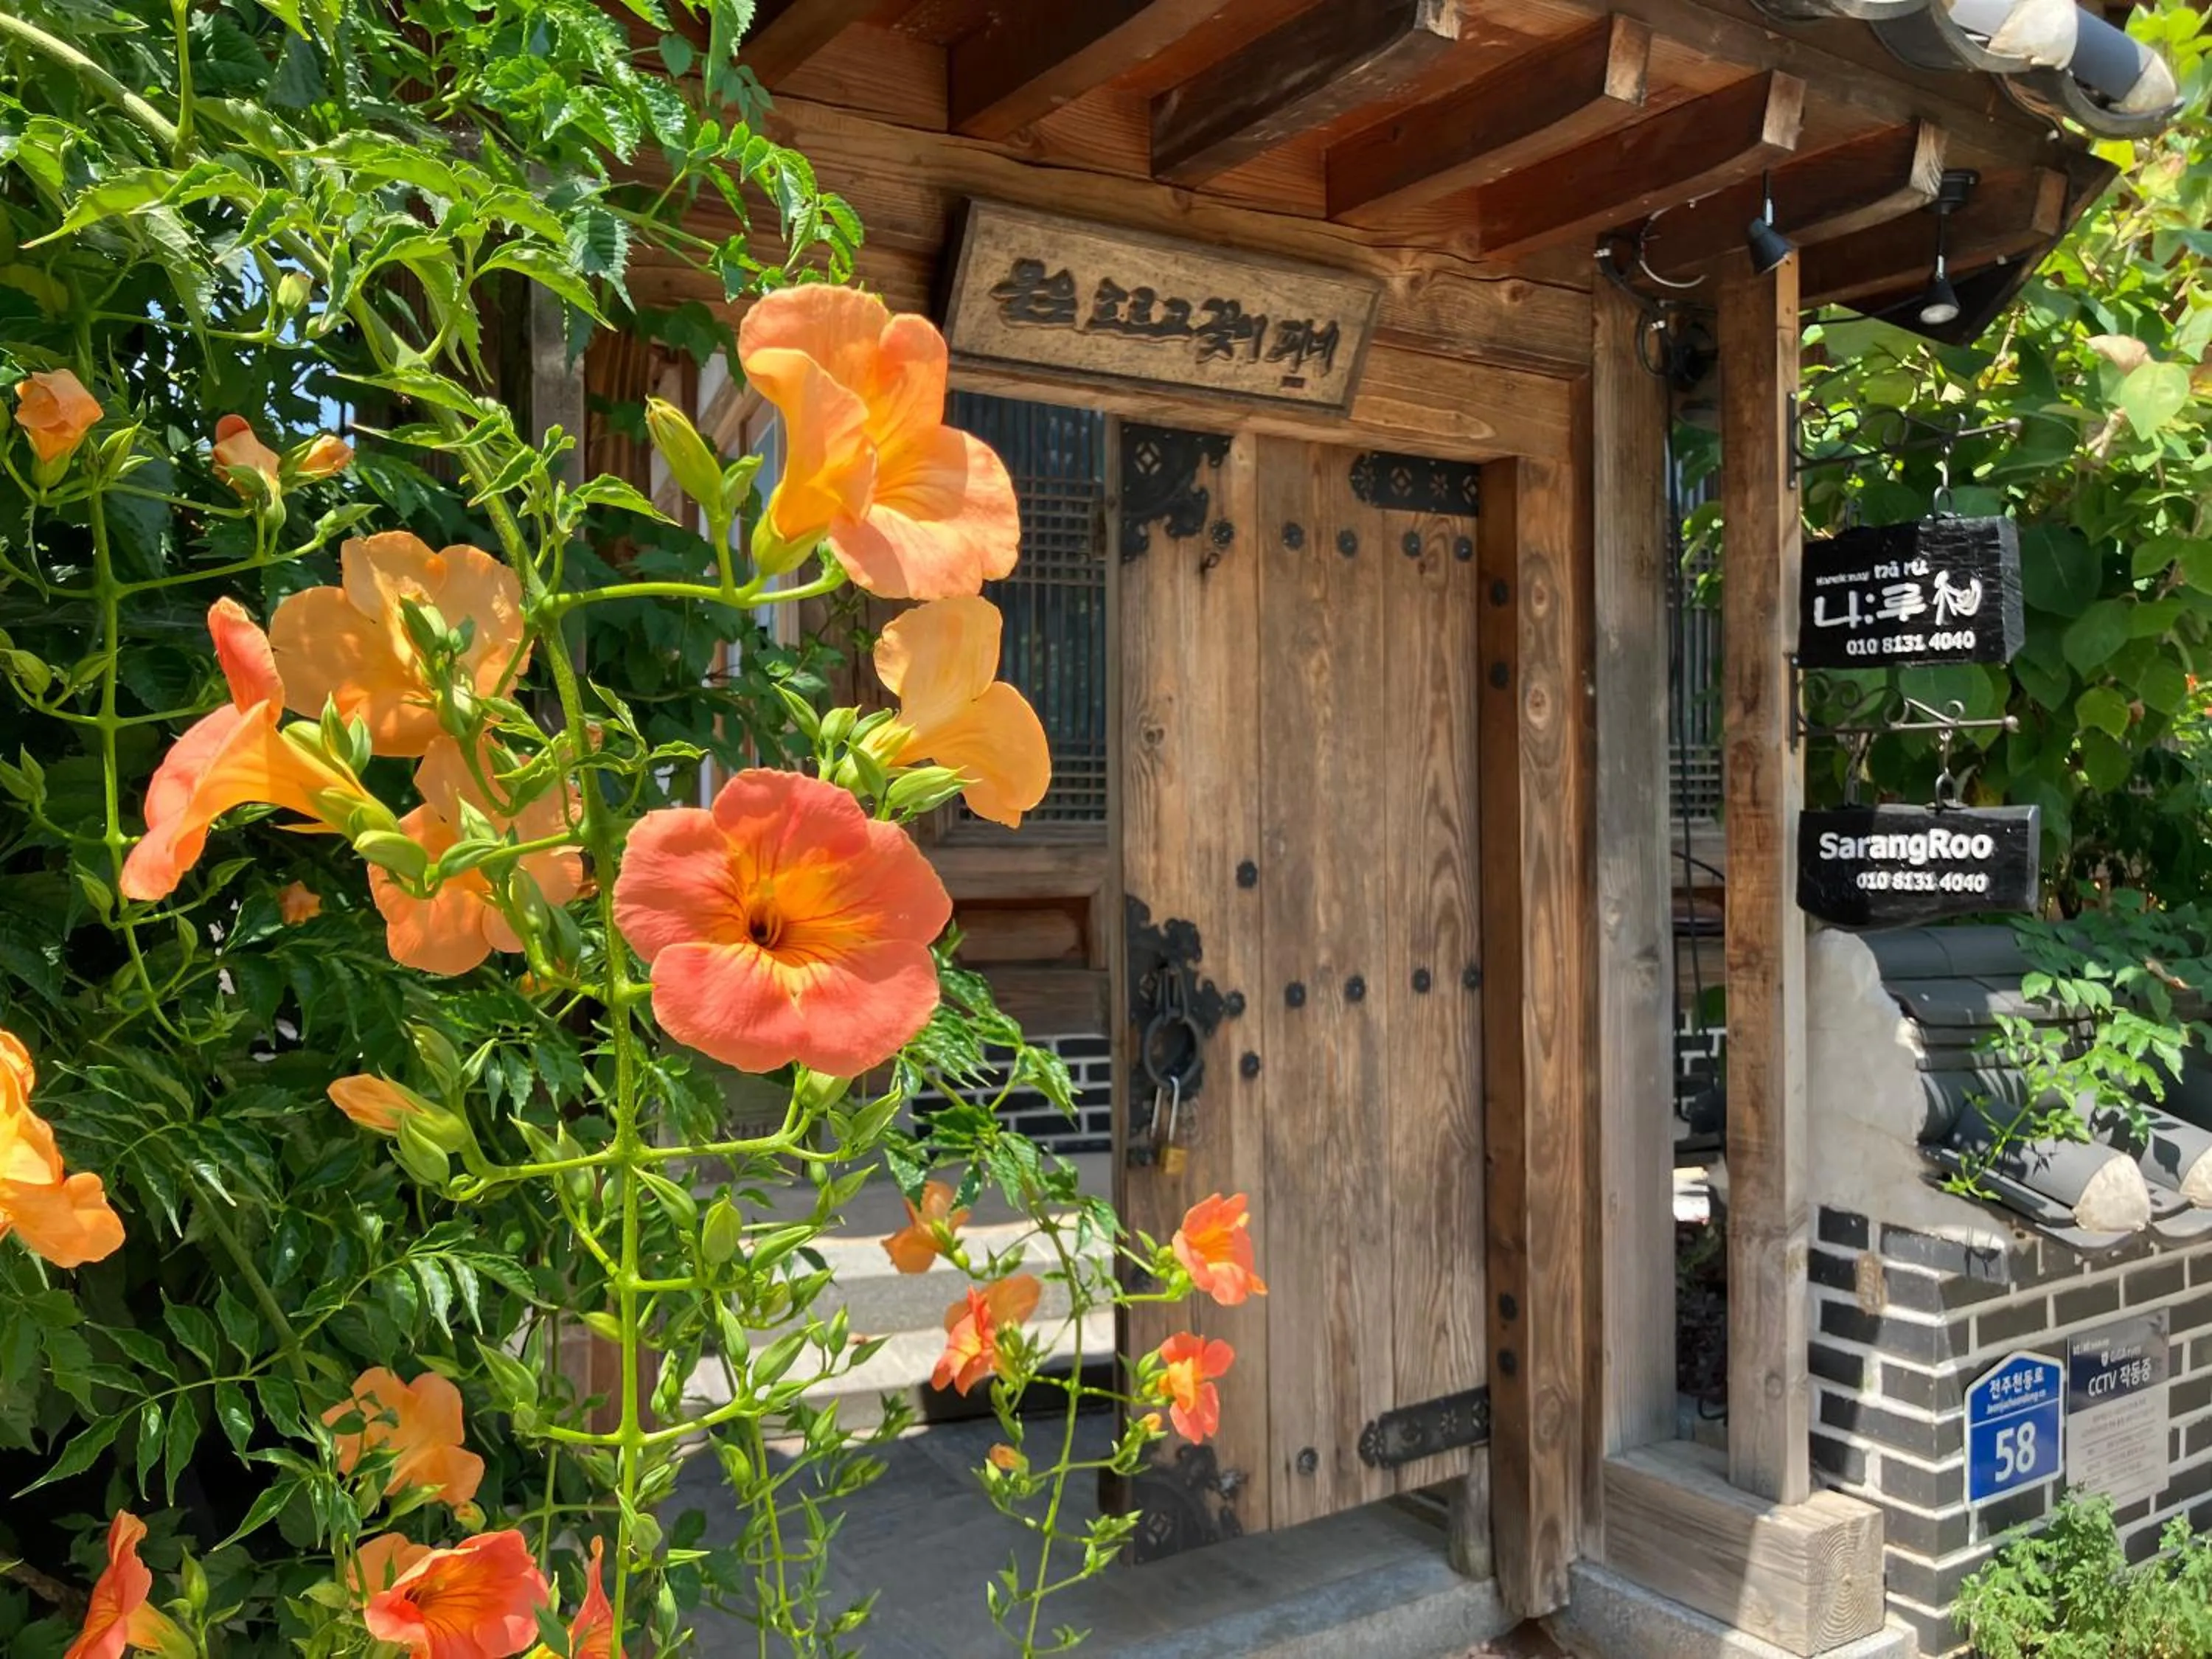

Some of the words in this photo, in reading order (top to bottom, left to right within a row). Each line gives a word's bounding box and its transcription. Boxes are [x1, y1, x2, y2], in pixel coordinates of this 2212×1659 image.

[1846, 639, 1877, 655] 010
[1882, 634, 1925, 653] 8131
[1929, 630, 1975, 650] 4040
[1819, 828, 1994, 865] SarangRoo
[1857, 872, 1889, 890] 010
[1891, 872, 1936, 891] 8131
[1938, 872, 1990, 892] 4040
[1989, 1366, 2045, 1399] 전주천동로
[2088, 1370, 2117, 1397] CCTV
[2120, 1357, 2152, 1388] 작동중
[1995, 1422, 2037, 1482] 58
